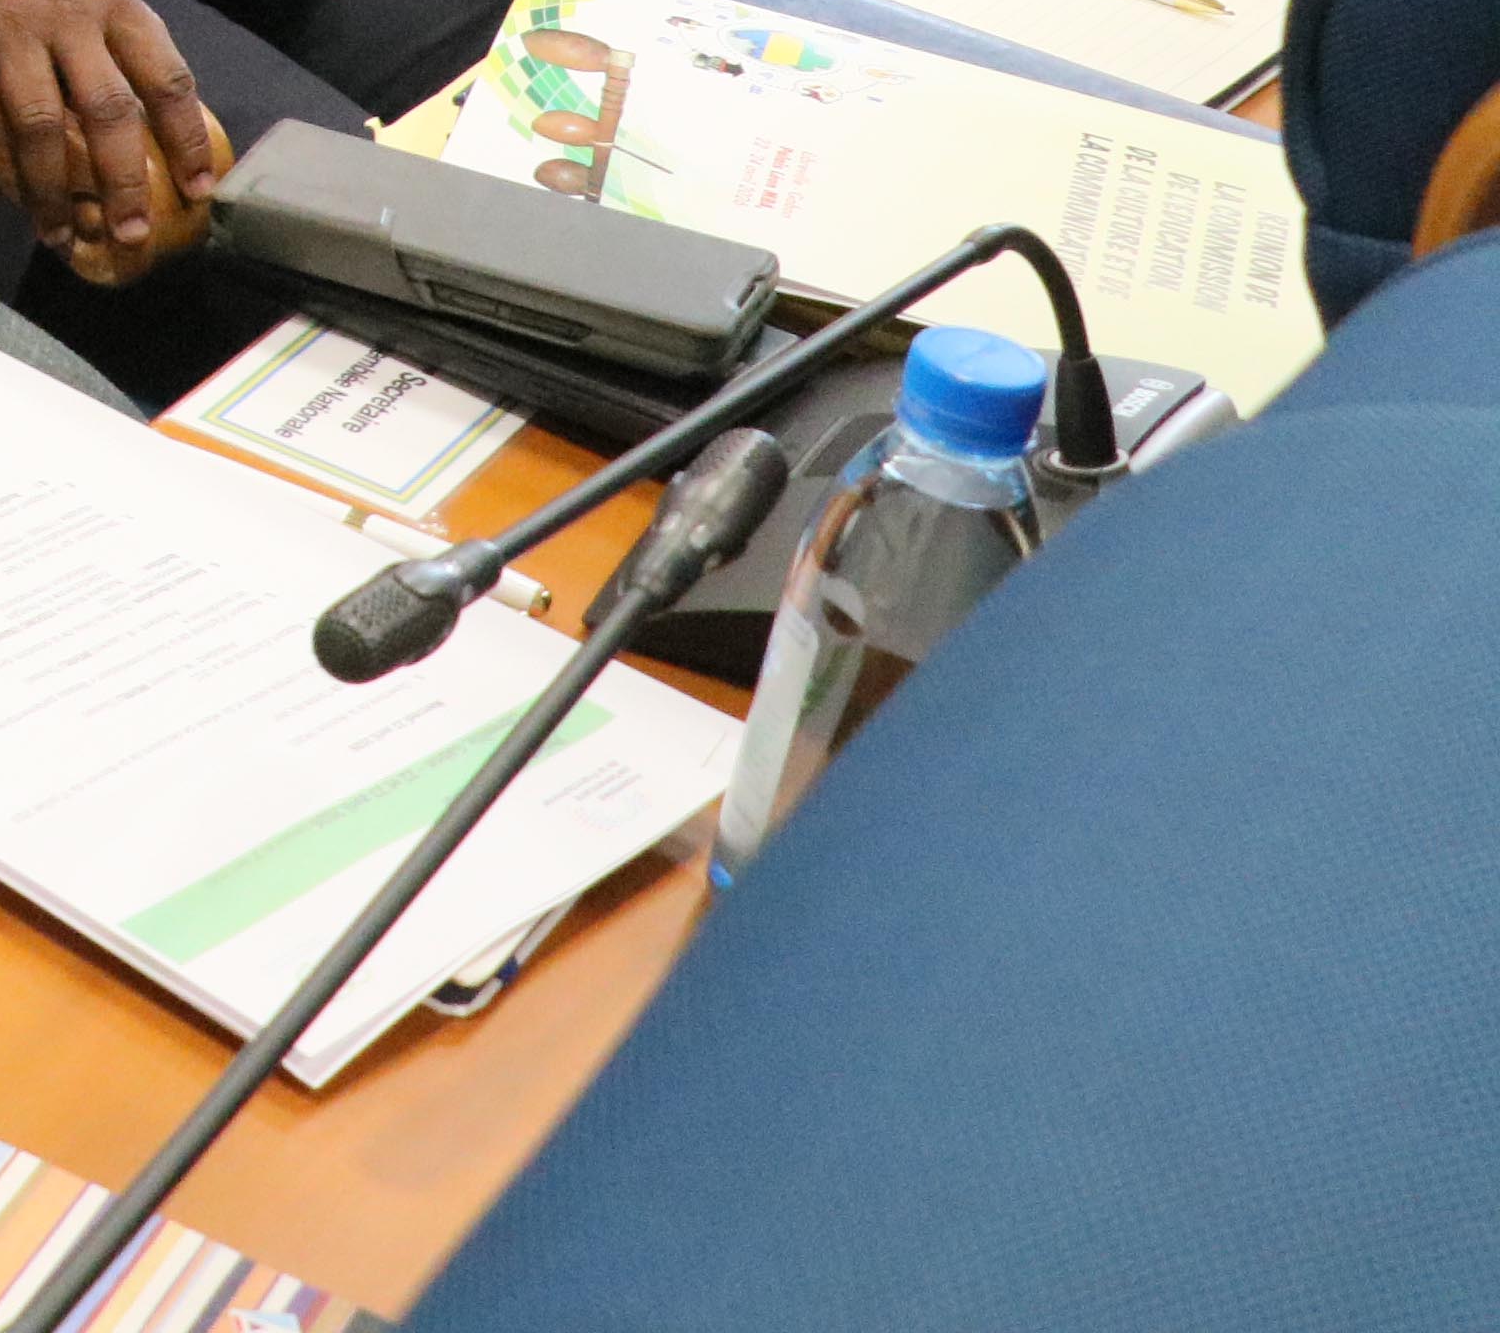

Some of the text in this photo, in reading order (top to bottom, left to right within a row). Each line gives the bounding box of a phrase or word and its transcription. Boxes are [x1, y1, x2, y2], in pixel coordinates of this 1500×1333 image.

[1079, 132, 1114, 153] LA
[1123, 145, 1158, 167] DE
[1118, 164, 1155, 186] LA
[1212, 180, 1247, 204] LA
[1105, 185, 1149, 256] CULTURE
[274, 386, 348, 438] Nationale
[341, 371, 427, 434] Secrétaire
